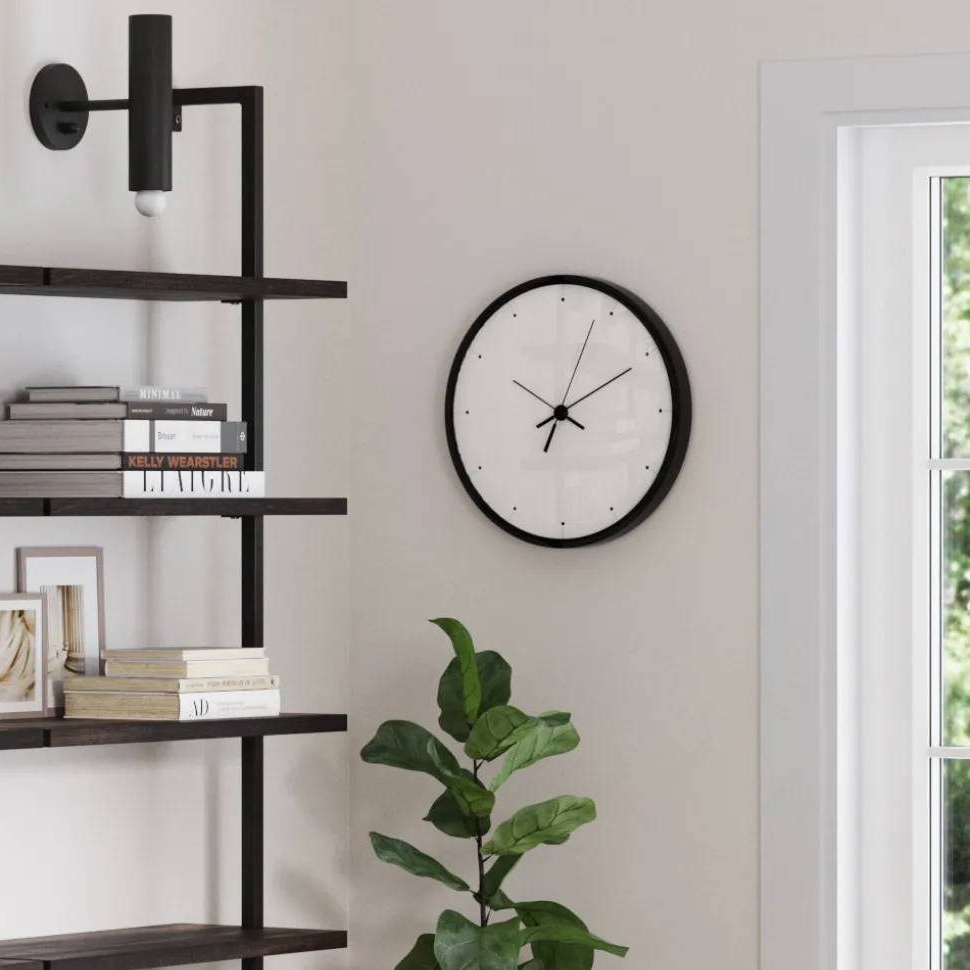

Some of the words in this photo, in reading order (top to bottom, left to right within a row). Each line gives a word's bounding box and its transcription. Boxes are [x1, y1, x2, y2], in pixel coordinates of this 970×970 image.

[139, 388, 182, 400] MINIMAL
[190, 406, 214, 417] Nature
[128, 455, 164, 468] KELLY
[167, 455, 238, 468] WEARSTLER
